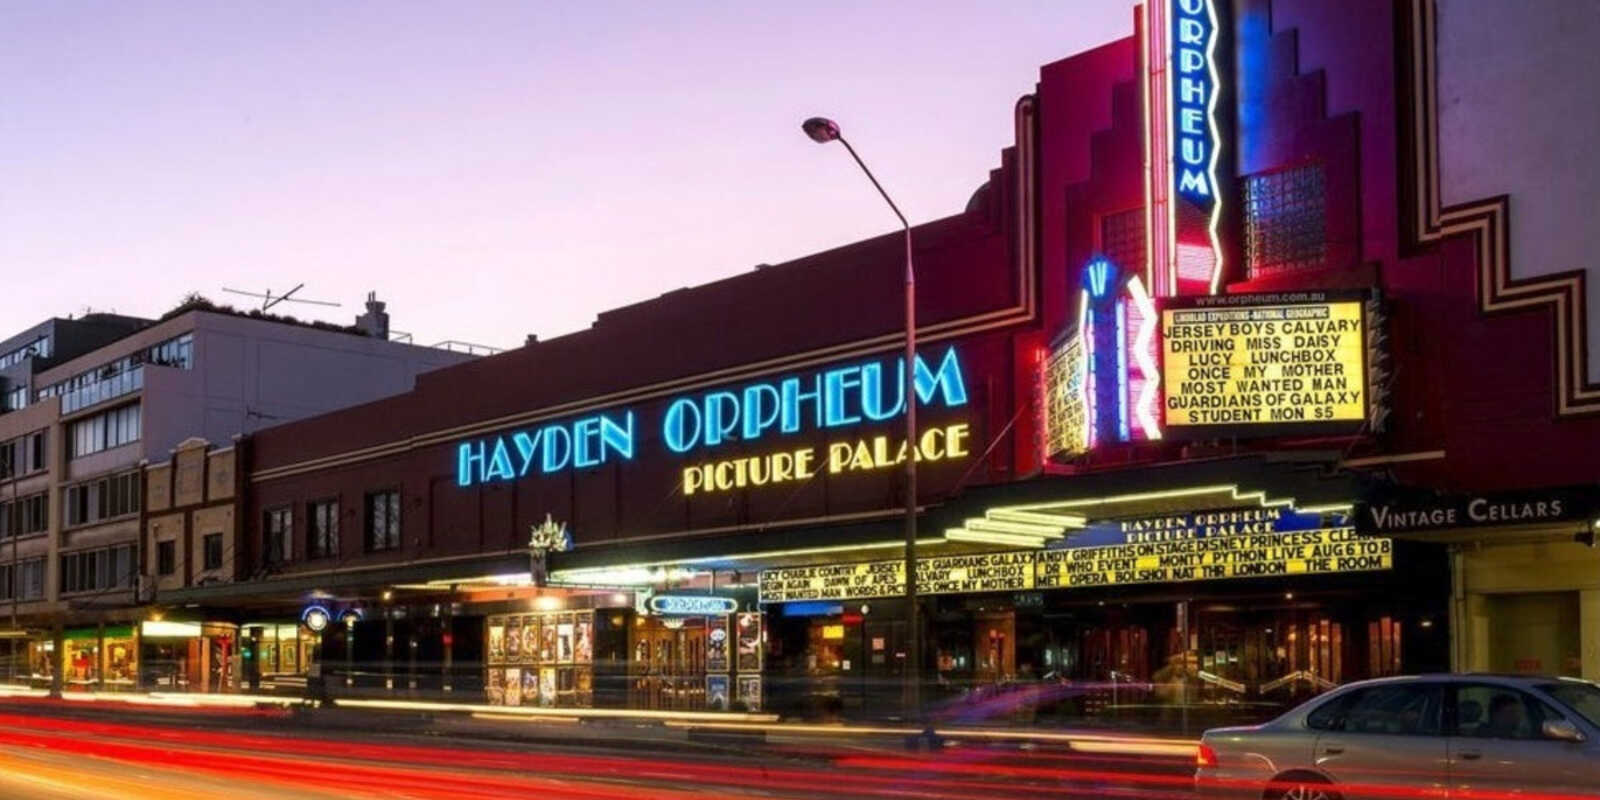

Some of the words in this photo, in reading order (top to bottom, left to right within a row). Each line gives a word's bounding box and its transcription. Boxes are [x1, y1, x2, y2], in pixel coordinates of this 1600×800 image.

[1196, 292, 1326, 305] www.orpheum.com.au
[1164, 324, 1224, 338] JERSEY
[1230, 323, 1275, 335] BOYS
[1282, 320, 1360, 334] CALVARY
[1171, 339, 1234, 353] DRIVING
[1246, 337, 1281, 350] MISS
[1294, 335, 1341, 348] DAISY
[1189, 353, 1233, 366] LUCY
[1251, 350, 1336, 364] LUNCHBOX
[1188, 367, 1231, 380] ONCE
[1244, 366, 1268, 378] MY
[1282, 364, 1344, 377] MOTHER
[1181, 382, 1226, 395] MOST
[1236, 379, 1303, 393] WANTED
[1312, 378, 1347, 391] MAN
[1168, 394, 1262, 409] GUARDIANS
[1265, 393, 1286, 406] OF
[1290, 392, 1360, 405] GALAXY
[458, 410, 634, 486] HAYDEN
[663, 345, 968, 453] ORPHEUM
[1189, 409, 1262, 423] STUDENT
[1270, 408, 1304, 420] MON
[1315, 407, 1334, 419] $5
[683, 448, 814, 495] PICTURE
[829, 423, 969, 474] PALACE
[1121, 517, 1186, 533] HAYDEN
[1195, 508, 1280, 526] ORPHEUM
[1371, 506, 1457, 528] VINTAGE
[1468, 498, 1562, 521] CELLARS
[1127, 528, 1196, 543] PICTURE
[1205, 522, 1274, 537] PALACE
[1038, 551, 1068, 563] ANDY
[1072, 546, 1136, 561] GRIFFITHS
[1138, 545, 1153, 557] ON
[1156, 542, 1195, 555] STAGE
[1198, 537, 1247, 550] DISNEY
[1250, 532, 1322, 547] PRINCESS
[1329, 529, 1366, 543] CLE
[866, 562, 901, 574] JERSEY
[932, 557, 989, 569] GUARDIANS
[991, 553, 1035, 565] GALAXY
[1045, 563, 1060, 574] DR
[1067, 561, 1093, 573] WHO
[1098, 558, 1136, 571] EVENT
[1159, 553, 1204, 566] MONTY
[1213, 549, 1267, 563] PYTHON
[1273, 546, 1305, 560] LIVE
[1312, 543, 1343, 557] AUG
[1346, 543, 1355, 555] 6
[1359, 542, 1379, 554] TO
[1381, 540, 1390, 552] 8
[854, 575, 867, 586] OF
[872, 574, 897, 585] APES
[909, 570, 951, 583] ALVARY
[967, 565, 1024, 579] LUNCHBOX
[1038, 575, 1060, 586] MET
[1069, 572, 1108, 585] OPERA
[1115, 569, 1167, 582] BOLSHOI
[1172, 567, 1195, 579] NAT
[1202, 564, 1225, 577] THR
[1233, 561, 1287, 576] LONDON
[1304, 558, 1331, 572] THE
[1338, 556, 1382, 570] ROOM
[934, 581, 960, 592] ONCE
[962, 580, 978, 590] MY
[981, 578, 1024, 589] MOTHER
